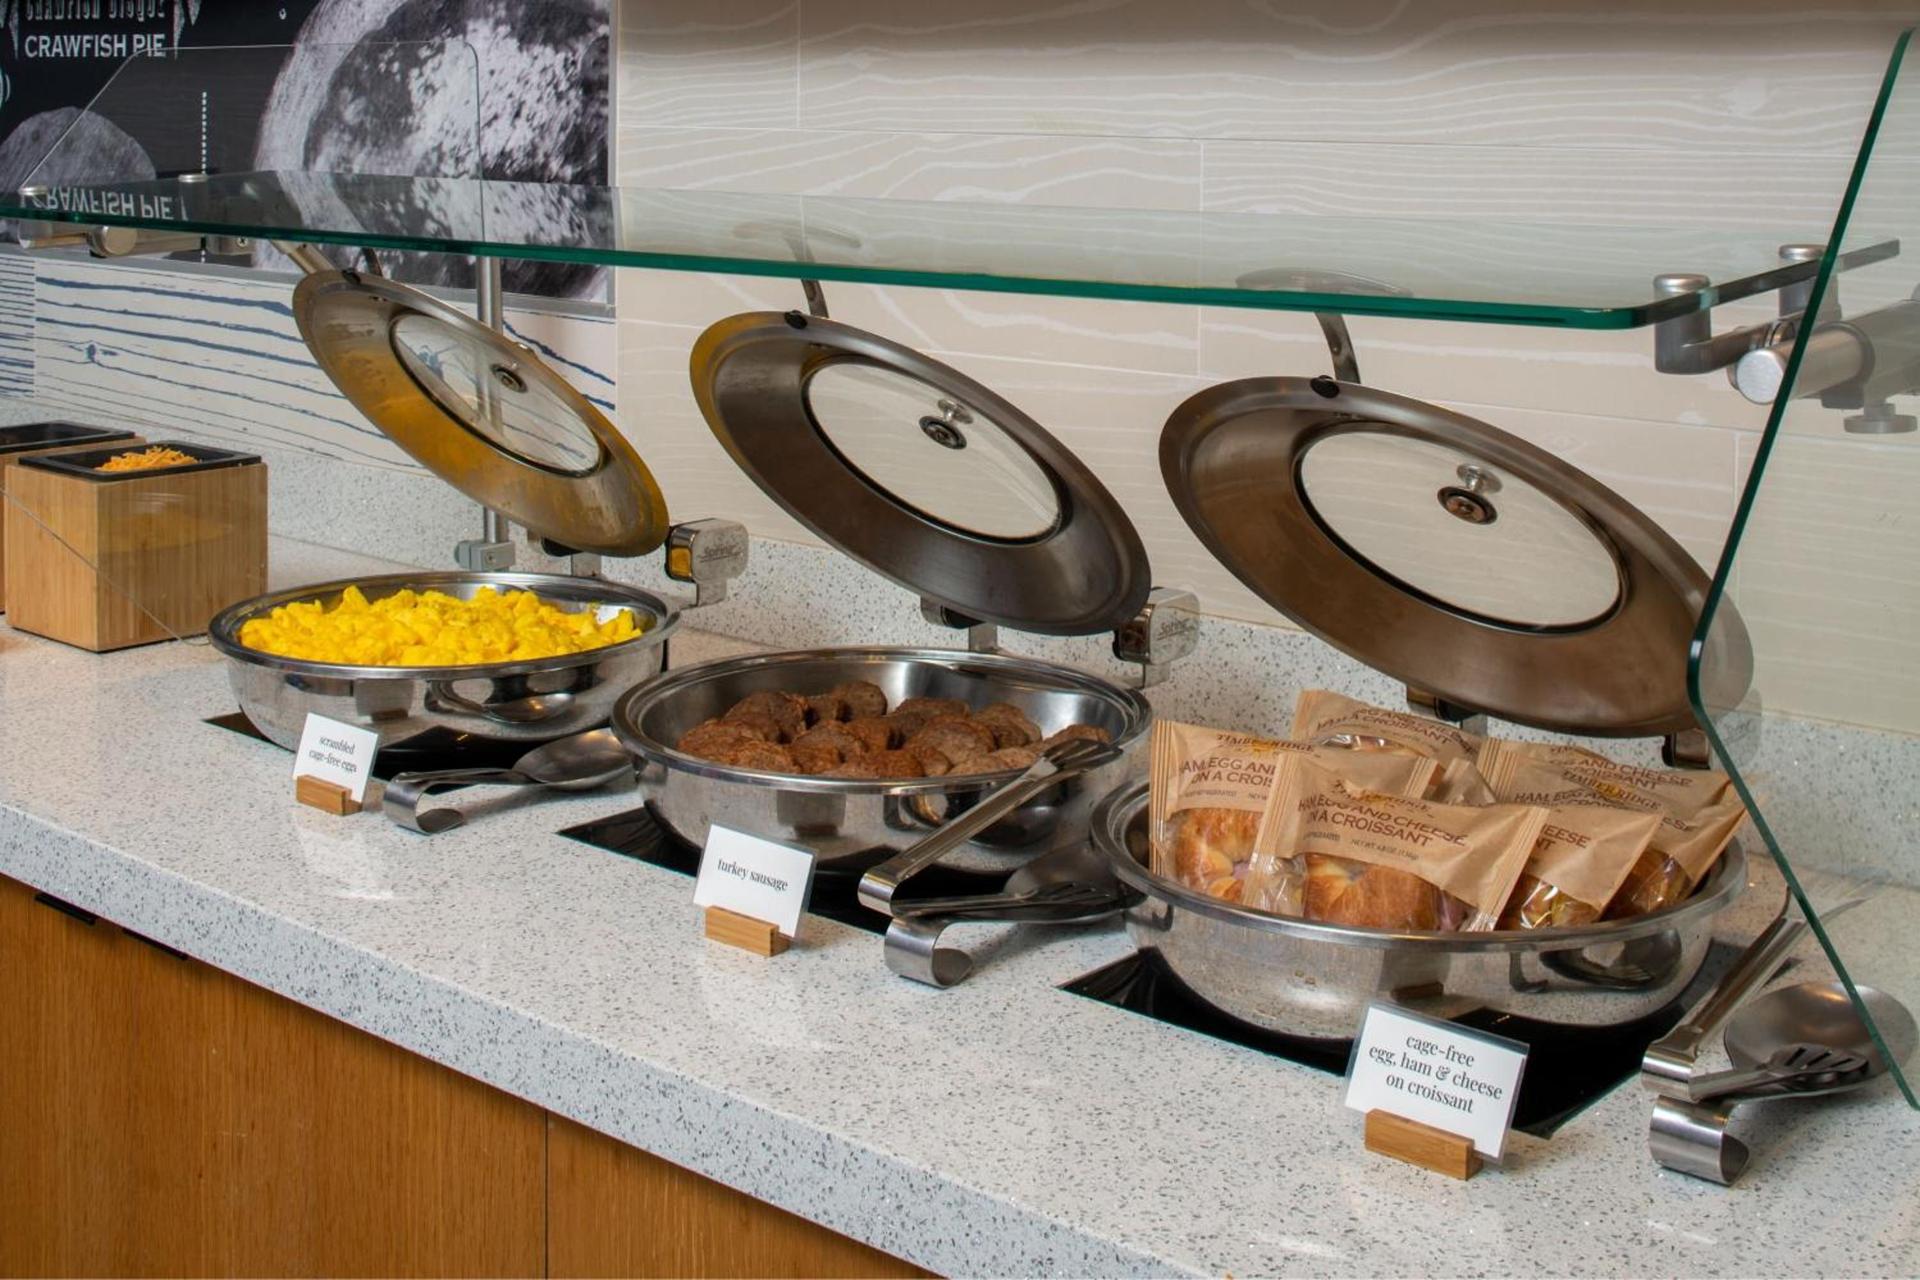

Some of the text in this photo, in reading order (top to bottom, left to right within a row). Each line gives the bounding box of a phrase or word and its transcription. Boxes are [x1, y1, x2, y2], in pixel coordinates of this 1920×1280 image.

[25, 34, 166, 58] CRAWFISH PIE
[319, 736, 356, 755] scrambled
[309, 750, 358, 774] cage-free eggs
[1208, 757, 1242, 770] EGG
[1212, 771, 1223, 781] A
[1578, 758, 1694, 788] AND CHEESE
[1331, 811, 1433, 847] CROISSANT
[1351, 805, 1392, 822] AND
[1394, 816, 1469, 846] CHEESE
[717, 858, 788, 893] turkey sausage
[1406, 1035, 1475, 1068] cage-free
[1369, 1045, 1503, 1100] egg, ham & cheese
[1386, 1073, 1474, 1114] on croissant
